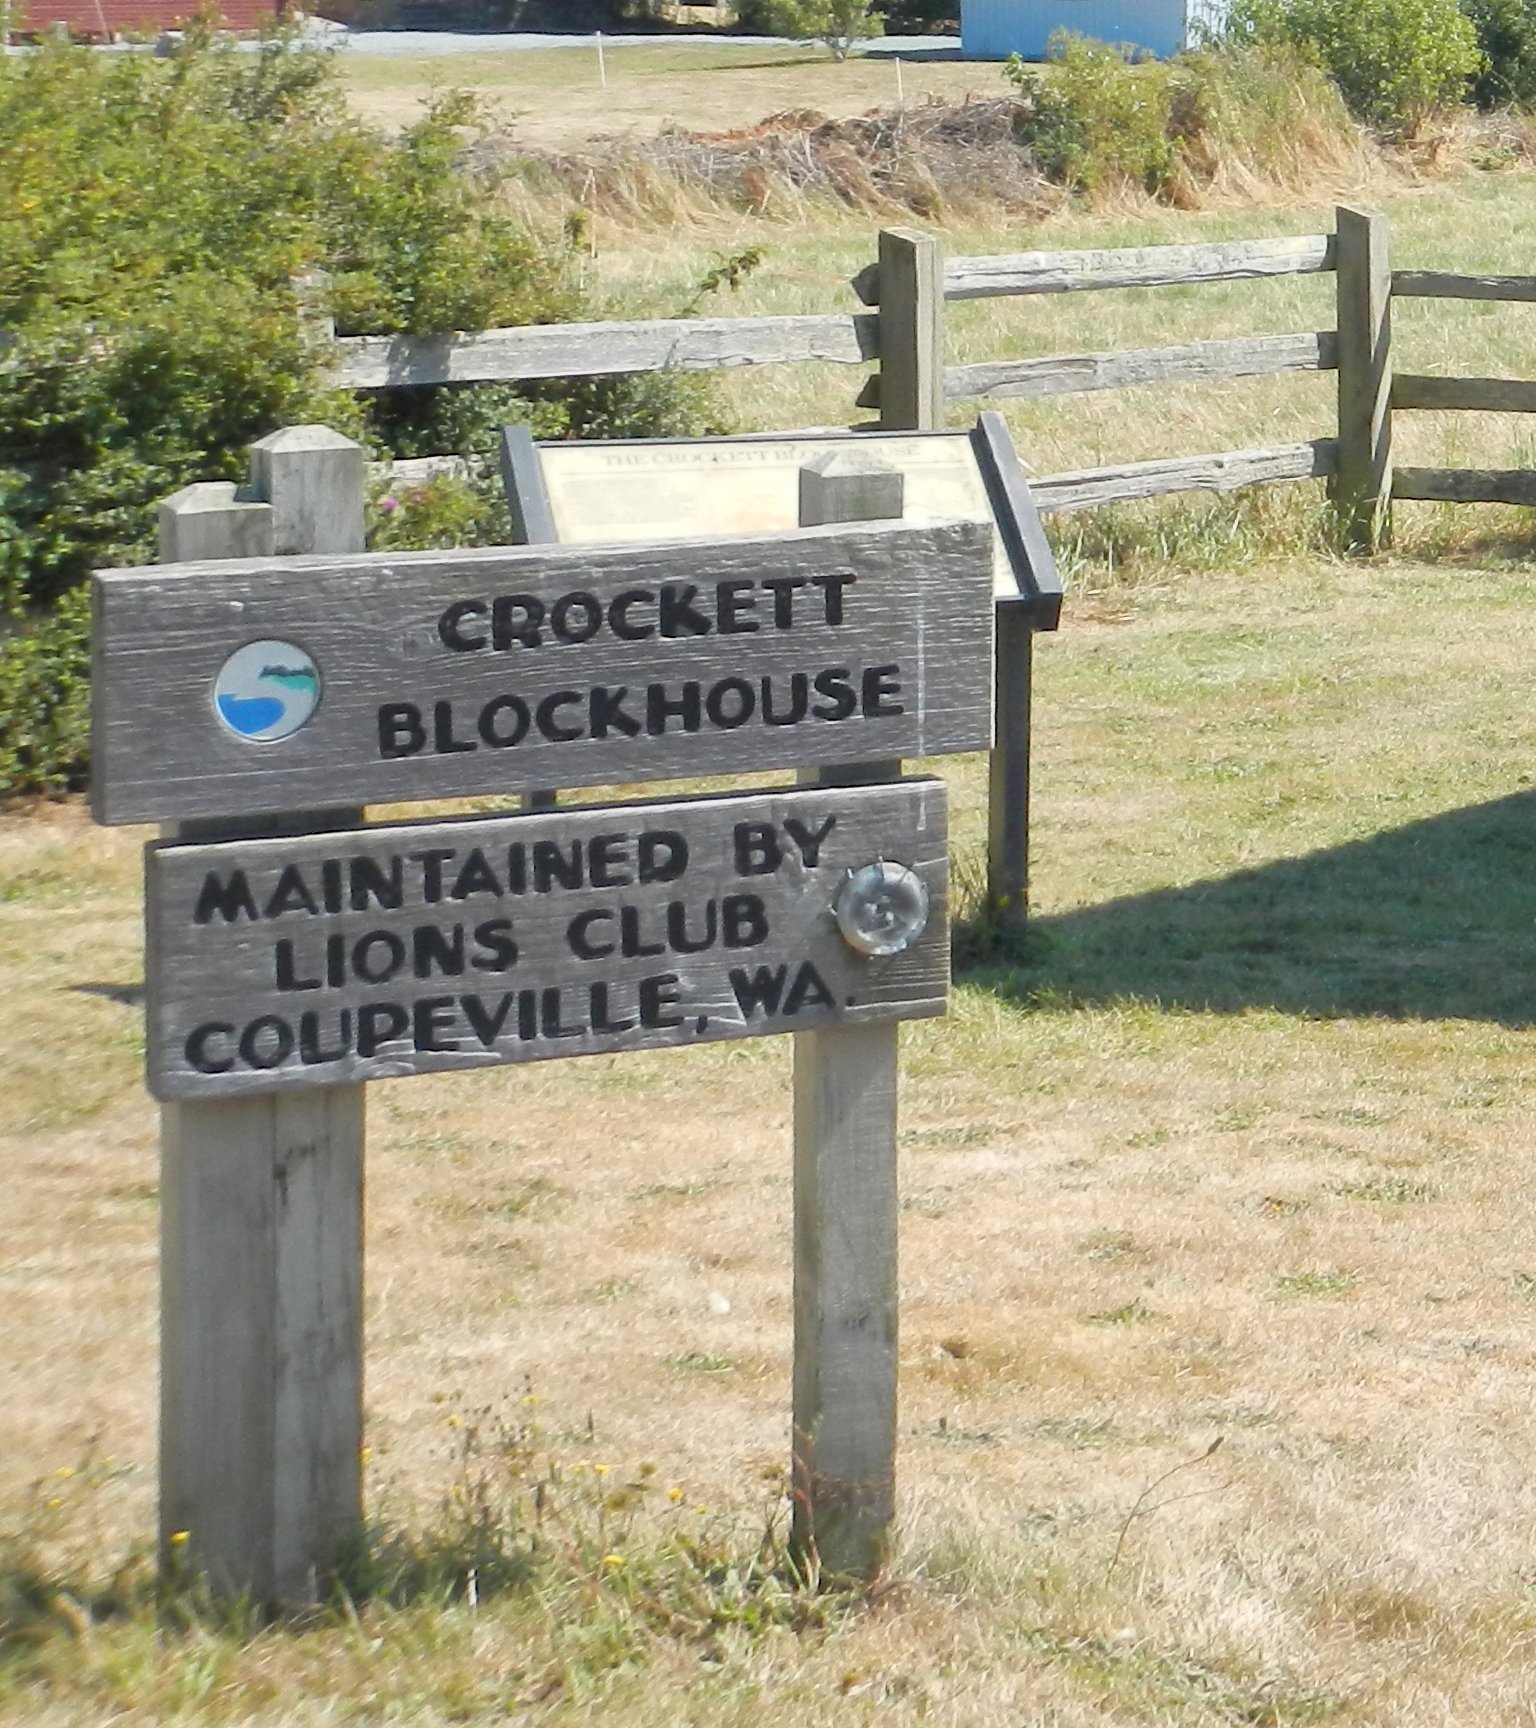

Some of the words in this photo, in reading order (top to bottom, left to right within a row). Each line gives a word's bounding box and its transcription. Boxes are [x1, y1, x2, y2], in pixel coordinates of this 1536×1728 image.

[652, 449, 769, 465] CROCKETT
[437, 573, 857, 653] CROCKETT
[377, 664, 905, 758] BLOCKHOUSE
[193, 830, 689, 924] MAINTAINED
[733, 815, 837, 874] BY
[274, 918, 519, 991] LIONS
[566, 894, 769, 960] CLUB
[184, 973, 708, 1074] COUPEVILLE,
[729, 965, 856, 1018] WA.
